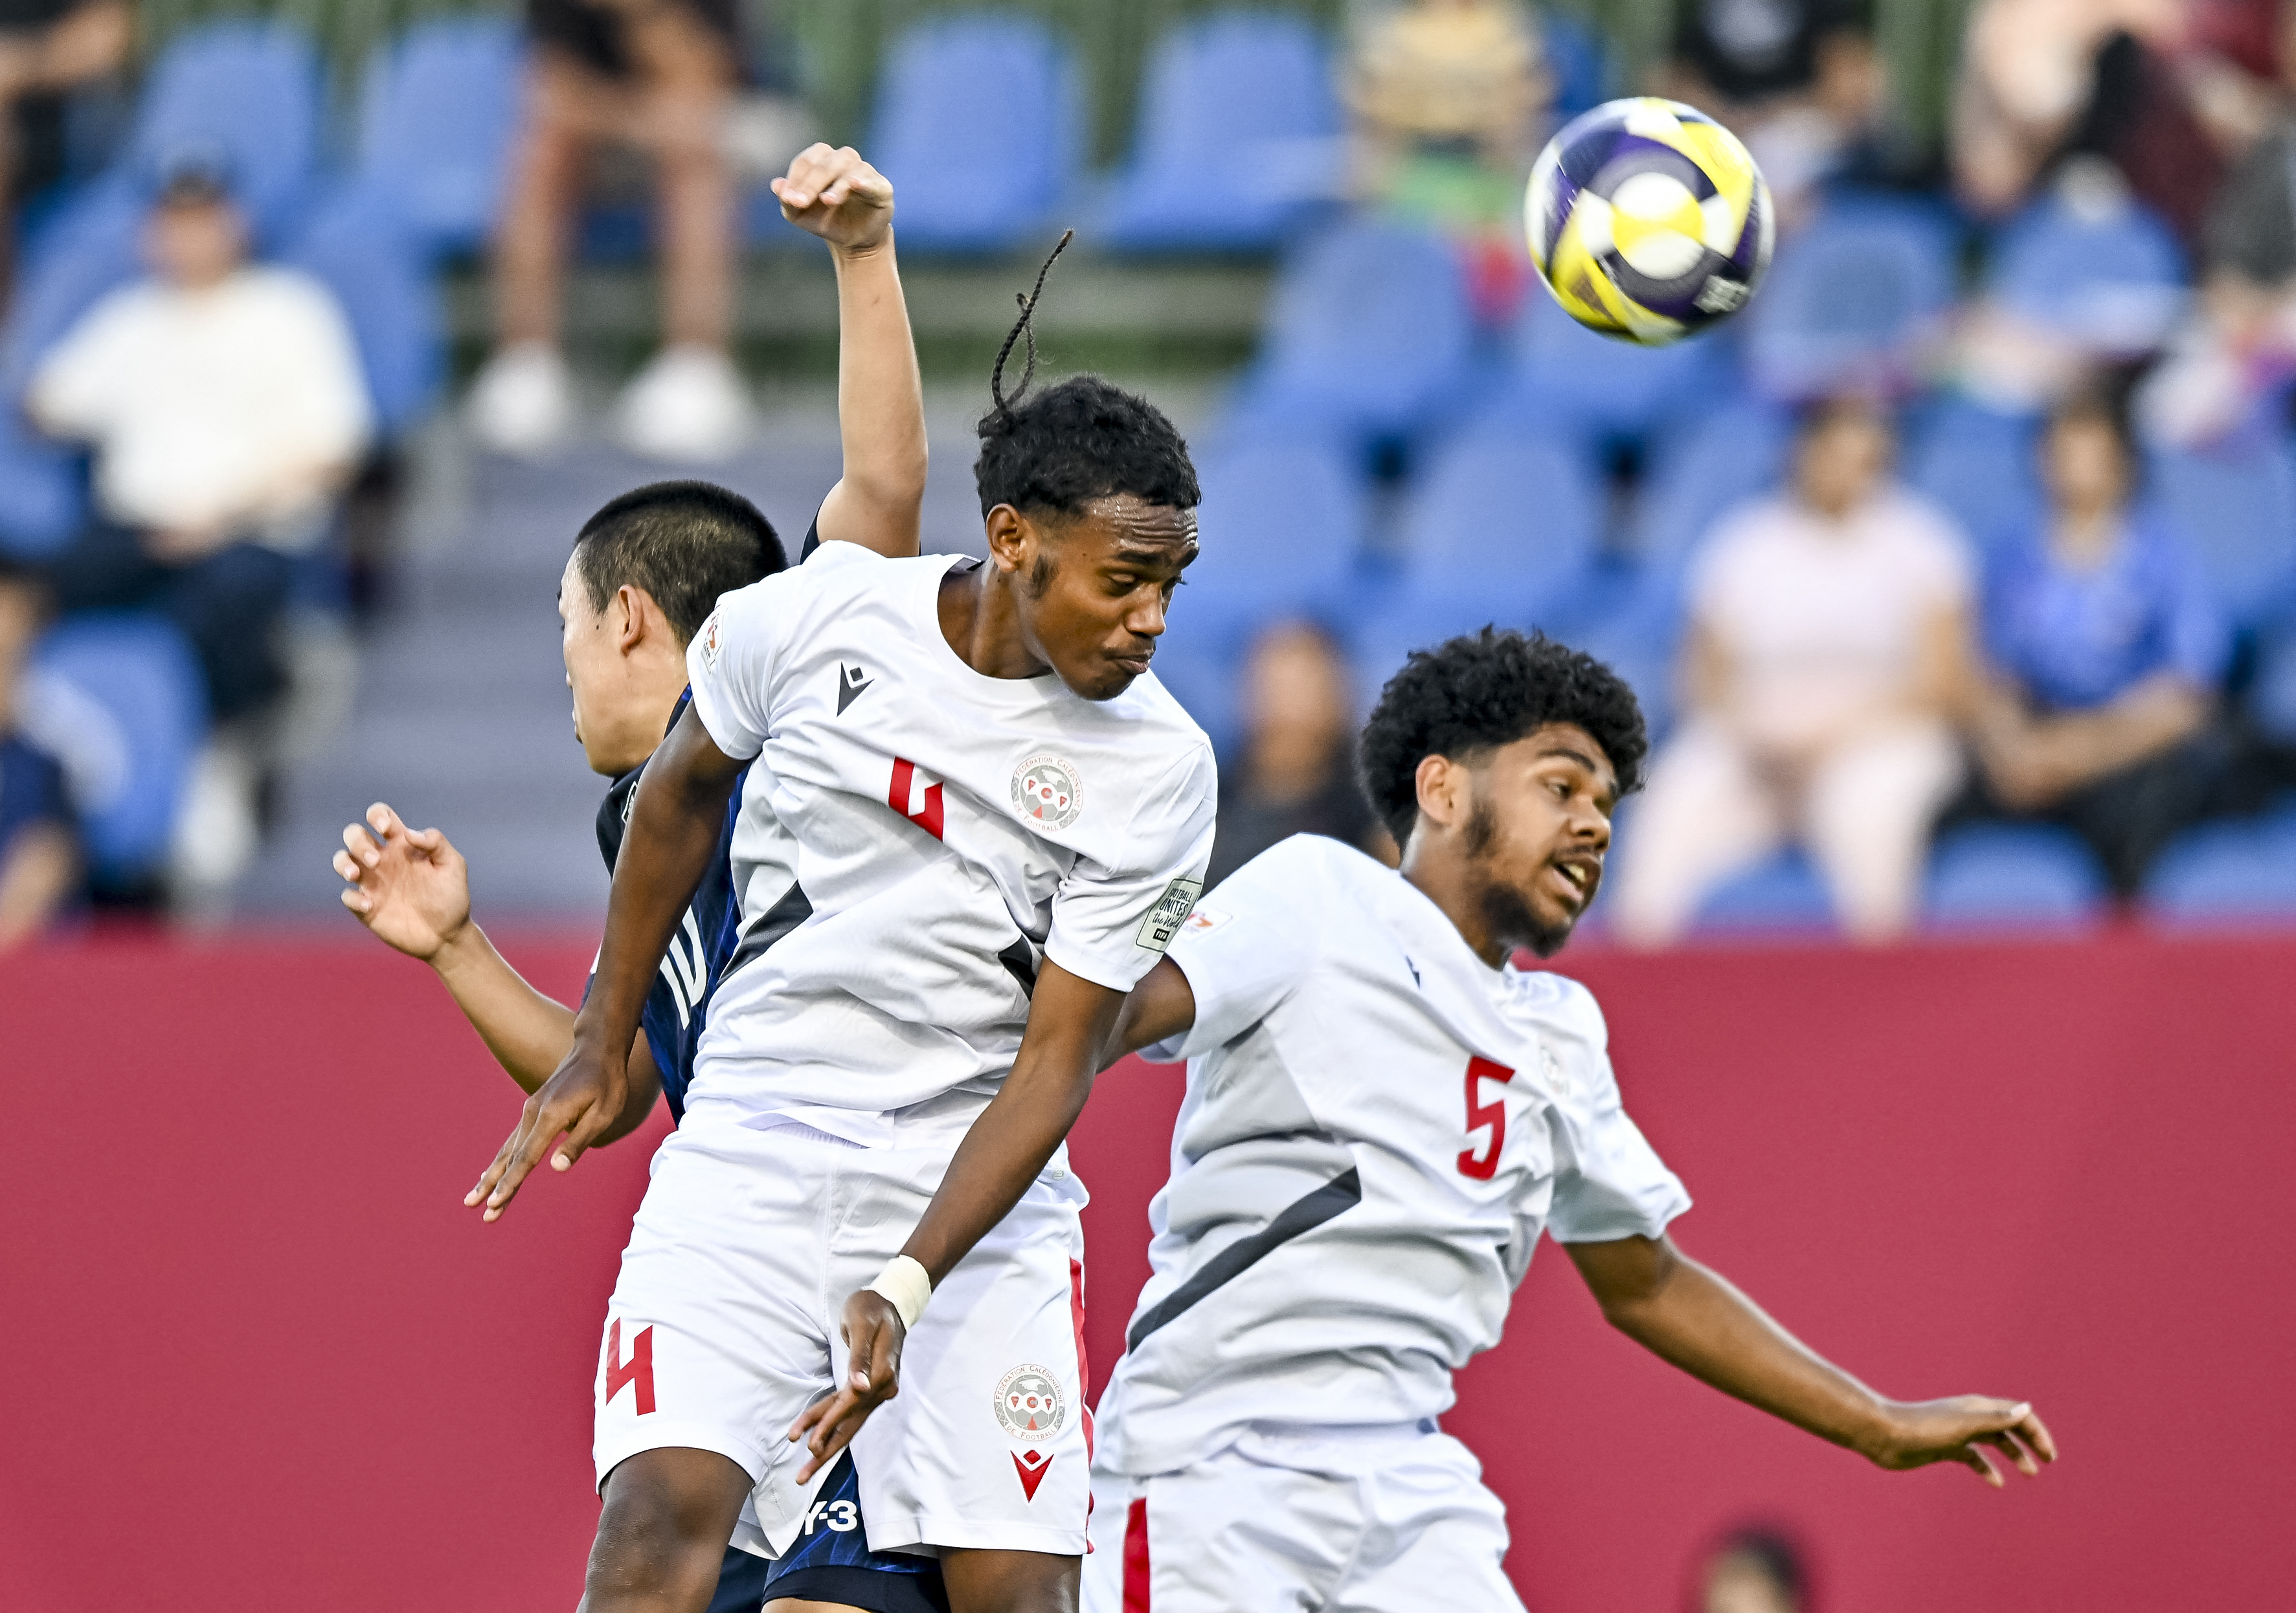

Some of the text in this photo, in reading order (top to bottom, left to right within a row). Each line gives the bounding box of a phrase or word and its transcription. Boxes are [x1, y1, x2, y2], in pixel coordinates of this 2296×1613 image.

[1159, 898, 1189, 917] UNITES
[1153, 912, 1164, 924] the
[1457, 1055, 1515, 1180] 5
[606, 1316, 657, 1416] 4
[1006, 1425, 1017, 1434] DE
[1020, 1428, 1056, 1440] FOOTBALL
[804, 1499, 858, 1536] Y-3
